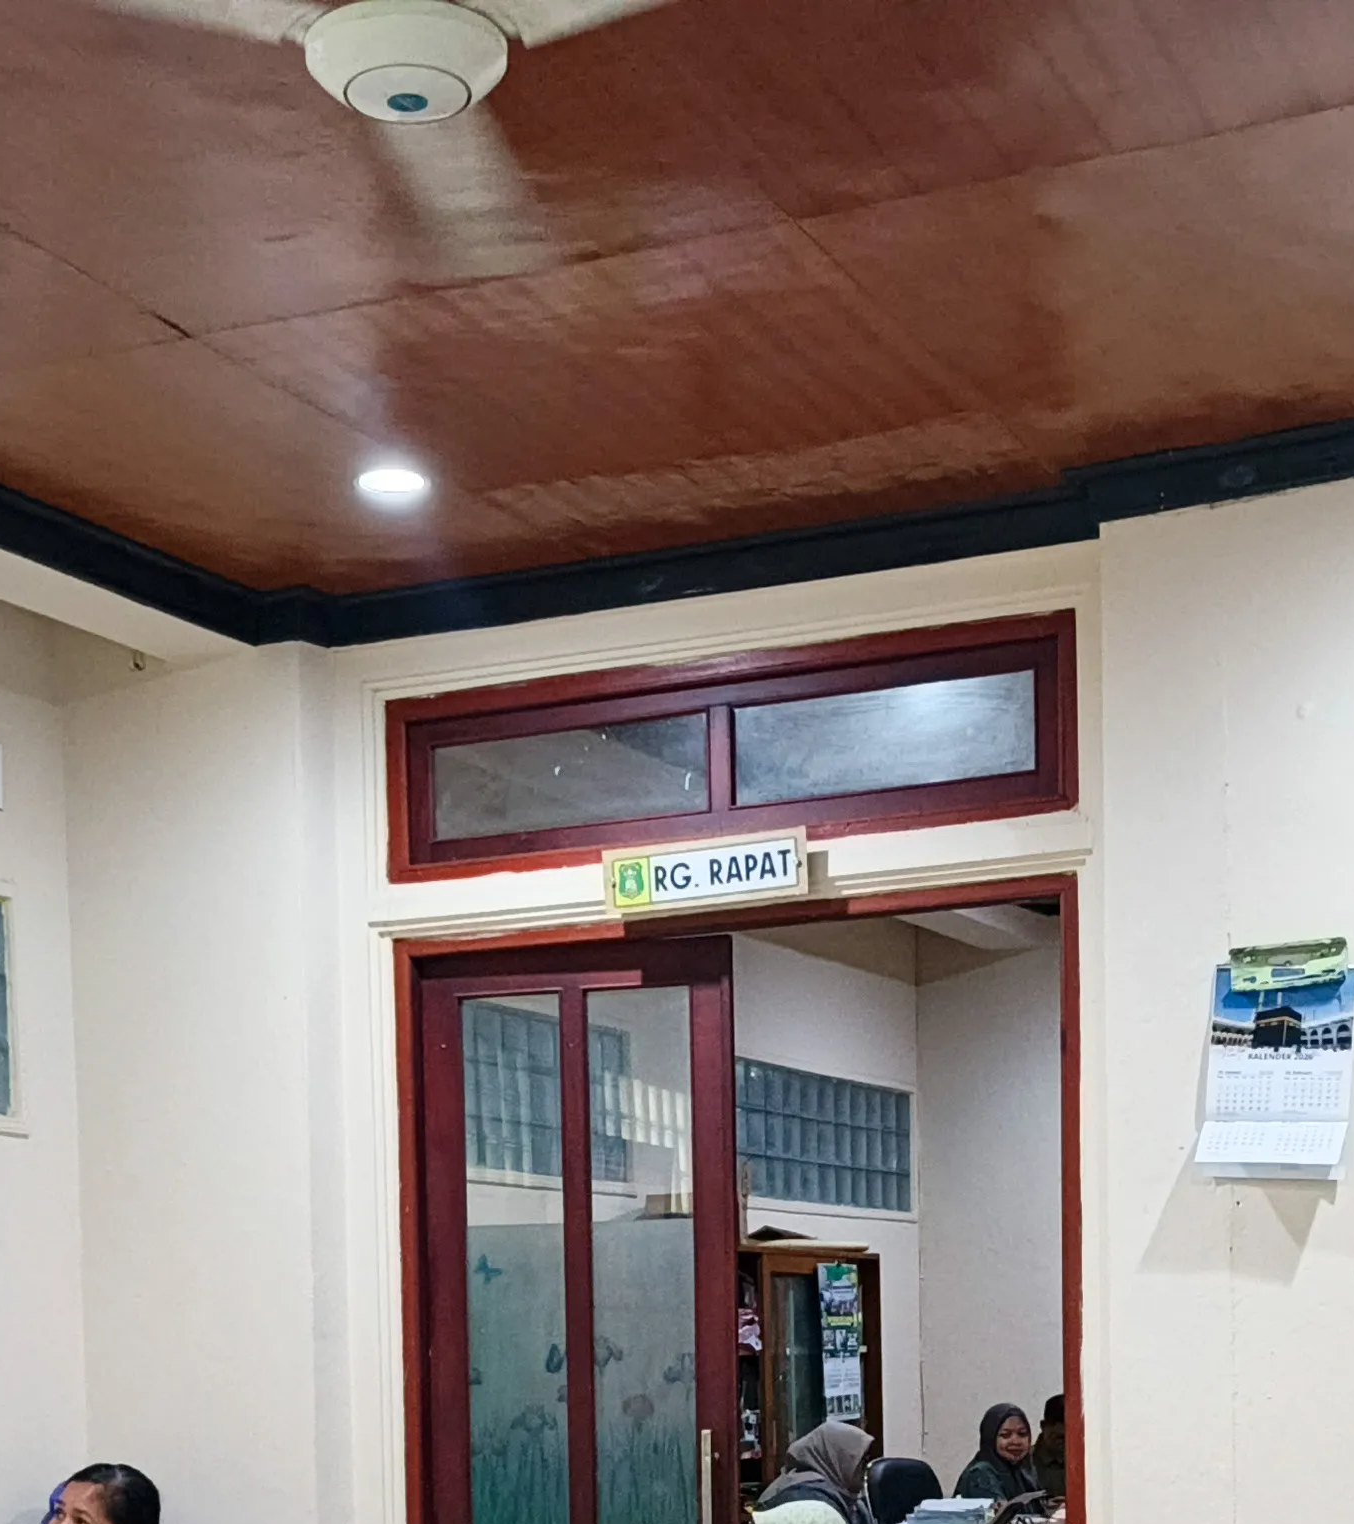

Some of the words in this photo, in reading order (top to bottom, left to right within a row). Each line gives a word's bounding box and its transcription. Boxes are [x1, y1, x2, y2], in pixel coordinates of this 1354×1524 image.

[654, 862, 699, 892] RG.
[709, 849, 791, 886] RAPAT
[1247, 1052, 1292, 1061] KALENDER
